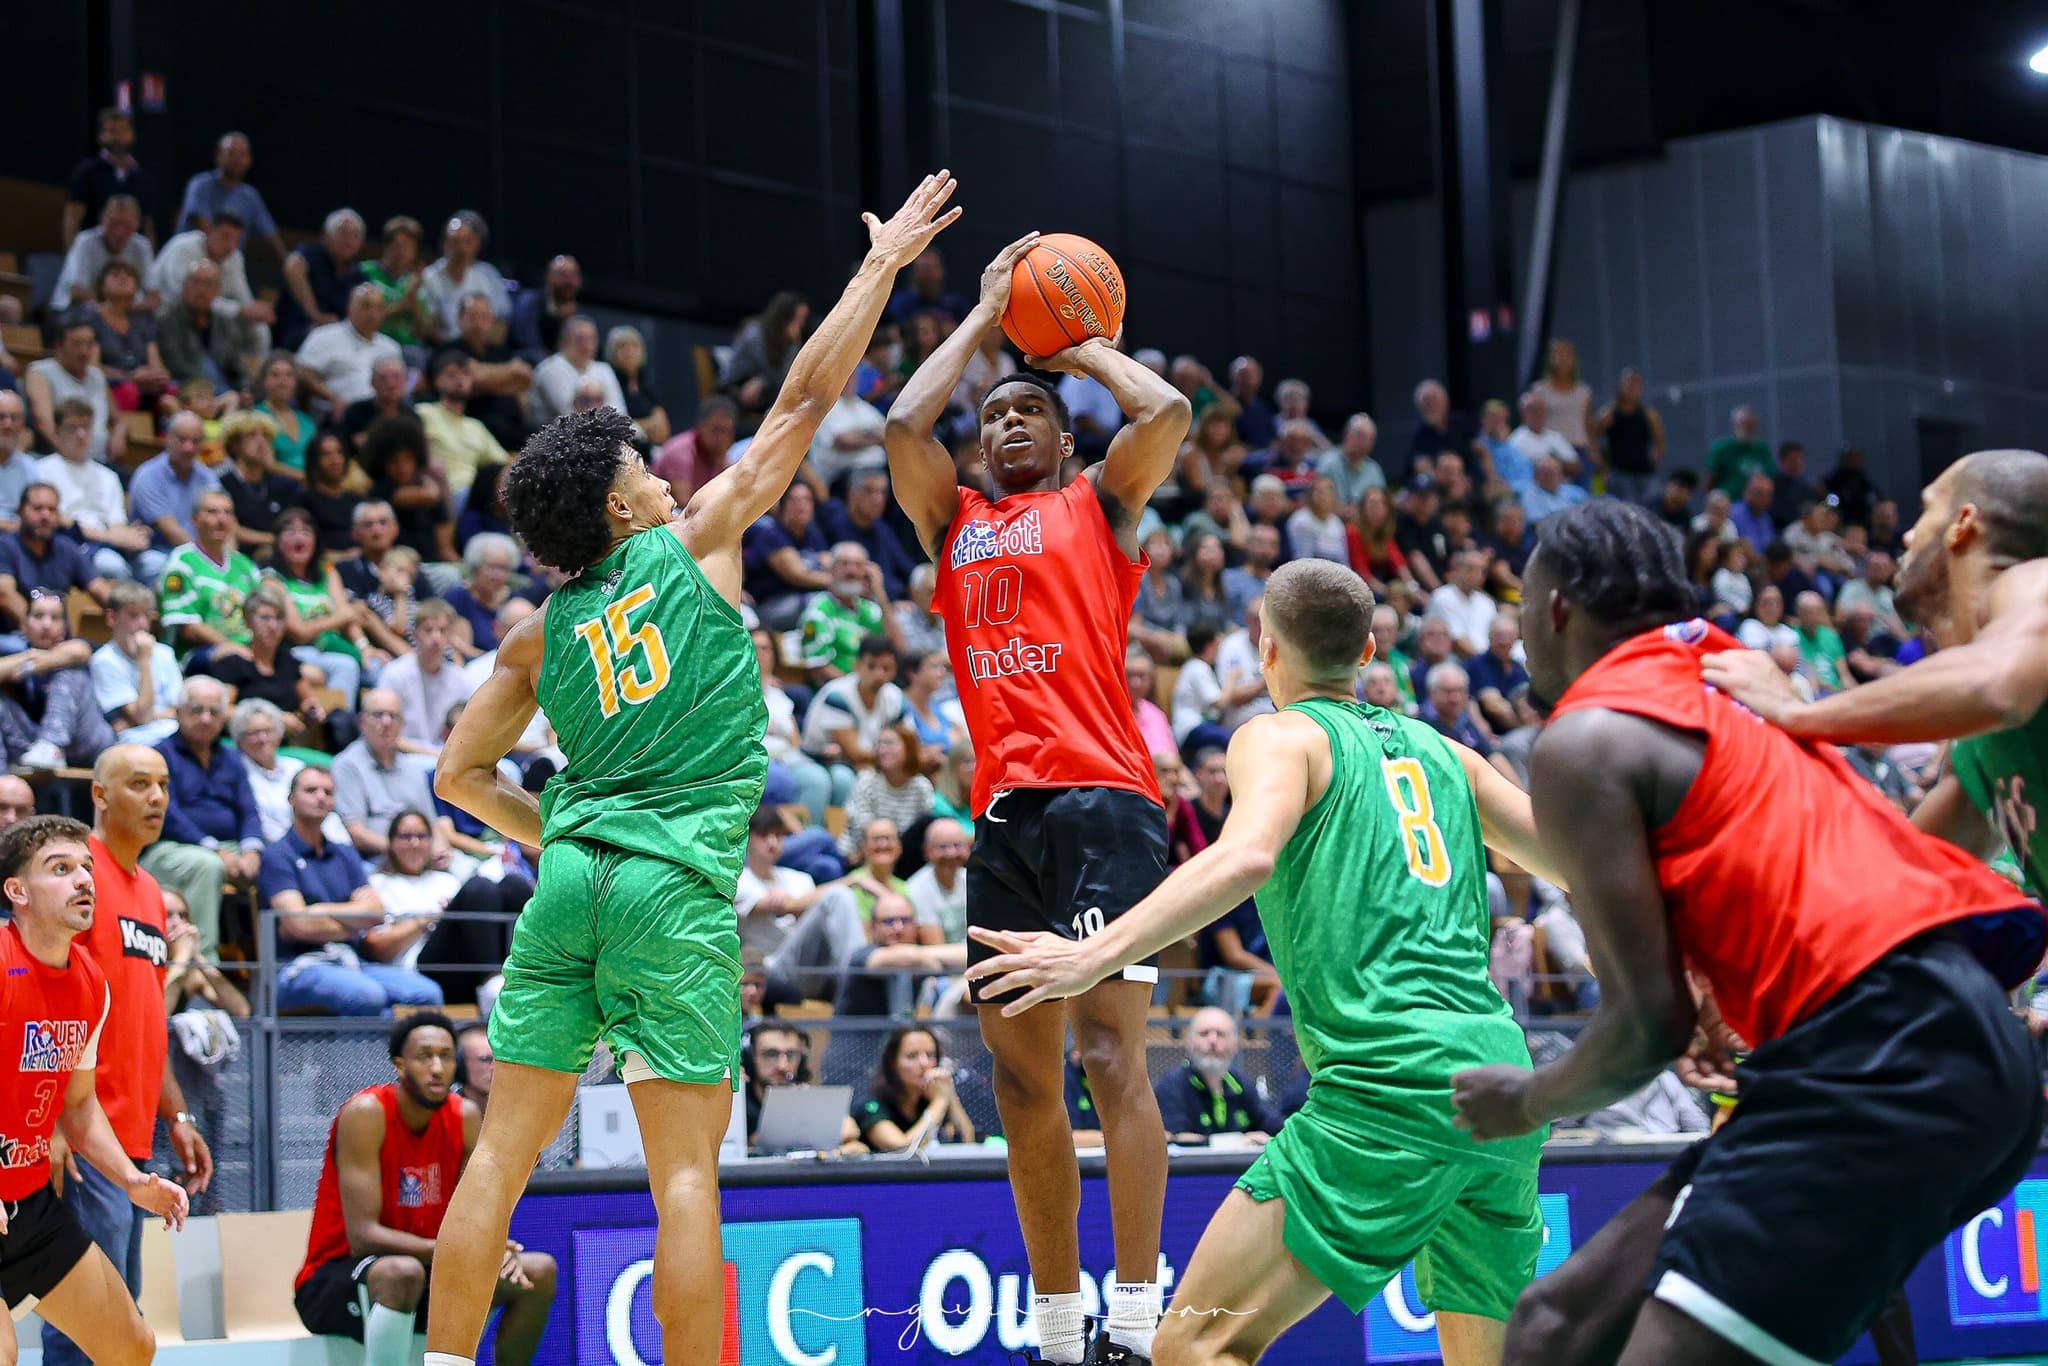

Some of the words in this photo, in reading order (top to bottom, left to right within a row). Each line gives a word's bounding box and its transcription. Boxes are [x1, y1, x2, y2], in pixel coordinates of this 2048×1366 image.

[1044, 258, 1105, 337] SPALDING
[964, 566, 1022, 629] 10
[574, 582, 671, 719] 15
[1380, 756, 1451, 887] 8
[25, 1020, 87, 1053] ROUEN
[25, 1079, 57, 1127] 3
